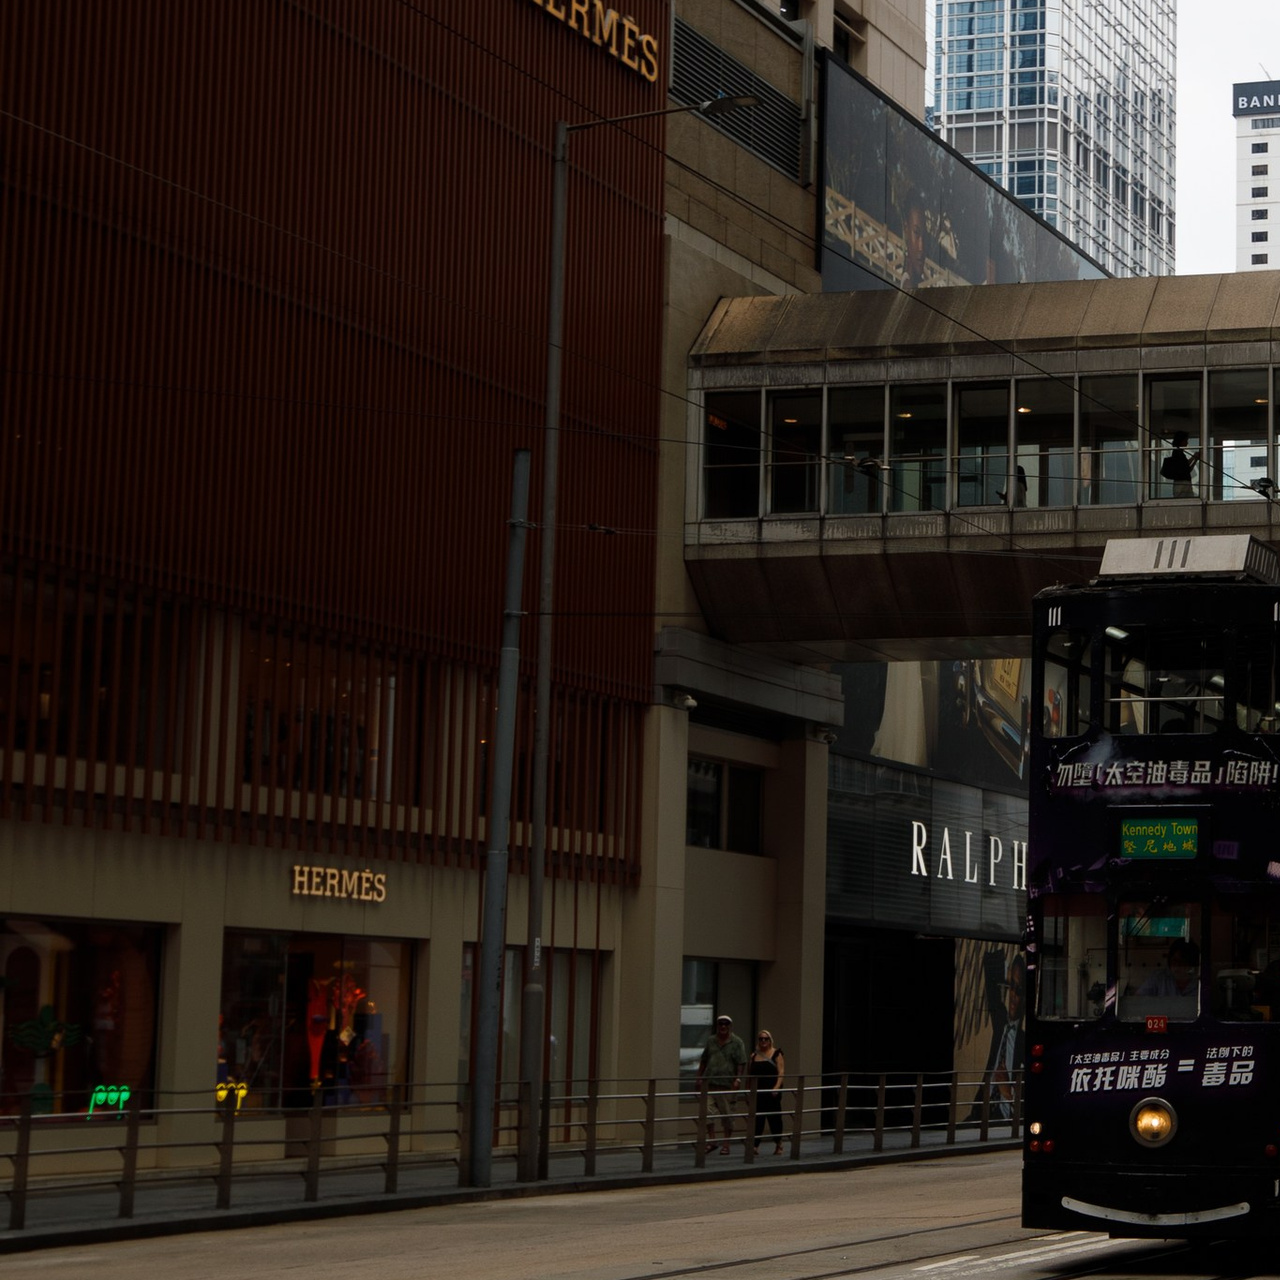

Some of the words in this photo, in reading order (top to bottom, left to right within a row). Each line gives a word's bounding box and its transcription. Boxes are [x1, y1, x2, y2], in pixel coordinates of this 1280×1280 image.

[1122, 822, 1167, 839] Kennedy
[1171, 822, 1199, 835] Town
[911, 820, 1028, 891] RALPH
[1123, 840, 1198, 854] 堅尼地城
[292, 864, 387, 903] HERMÈS
[1146, 1019, 1165, 1029] 024
[1205, 1045, 1255, 1059] 法例下的
[1069, 1063, 1169, 1094] 依托咪酯
[1201, 1059, 1256, 1088] 毒品
